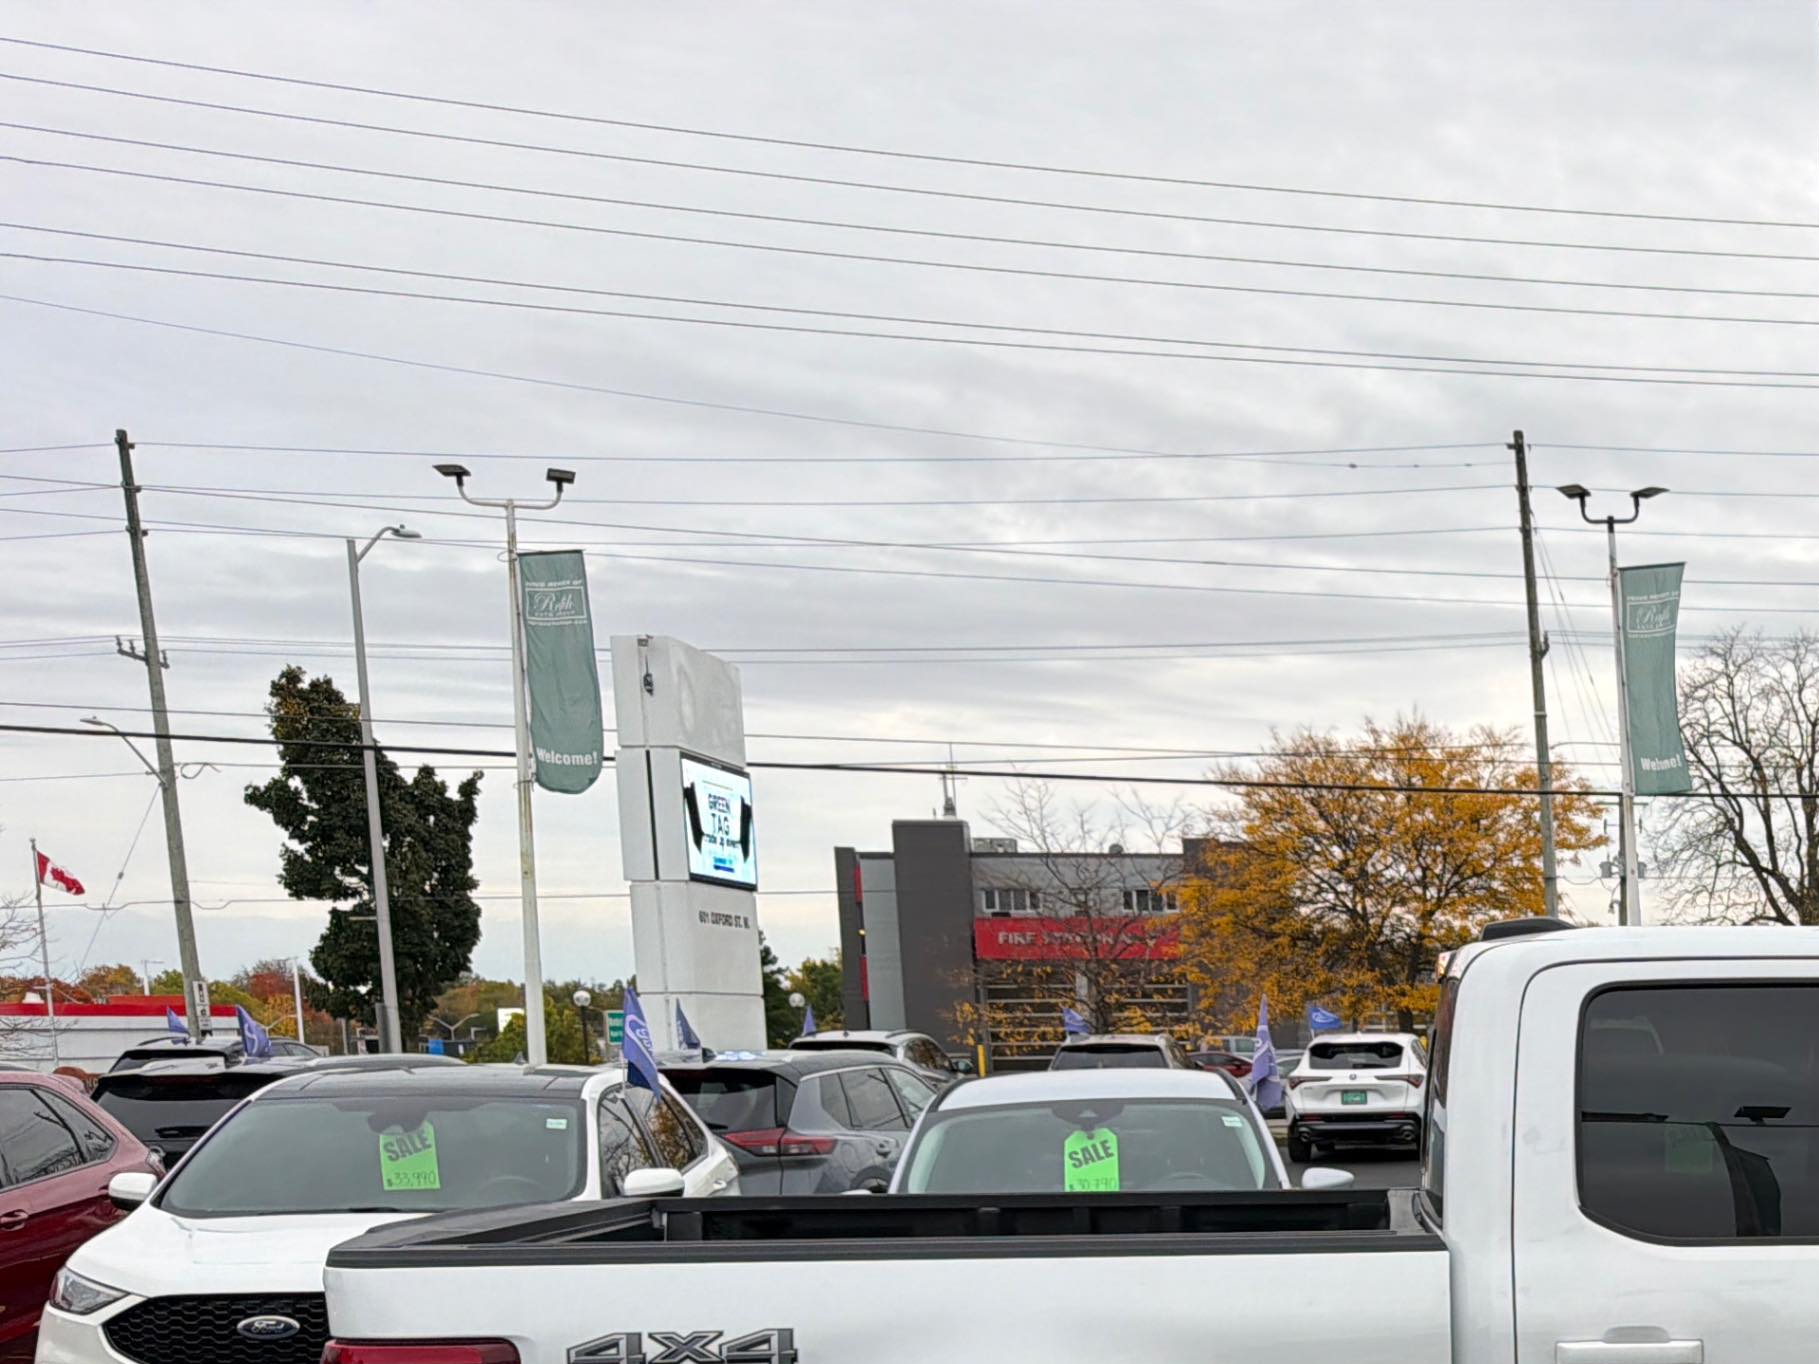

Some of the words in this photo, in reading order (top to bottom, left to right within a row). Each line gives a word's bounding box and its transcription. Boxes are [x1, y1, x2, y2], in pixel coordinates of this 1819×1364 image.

[535, 746, 598, 766] Welcome!
[711, 812, 730, 836] TAG
[997, 931, 1036, 945] FIRE
[383, 1130, 432, 1162] SALE
[1068, 1139, 1115, 1169] SALE
